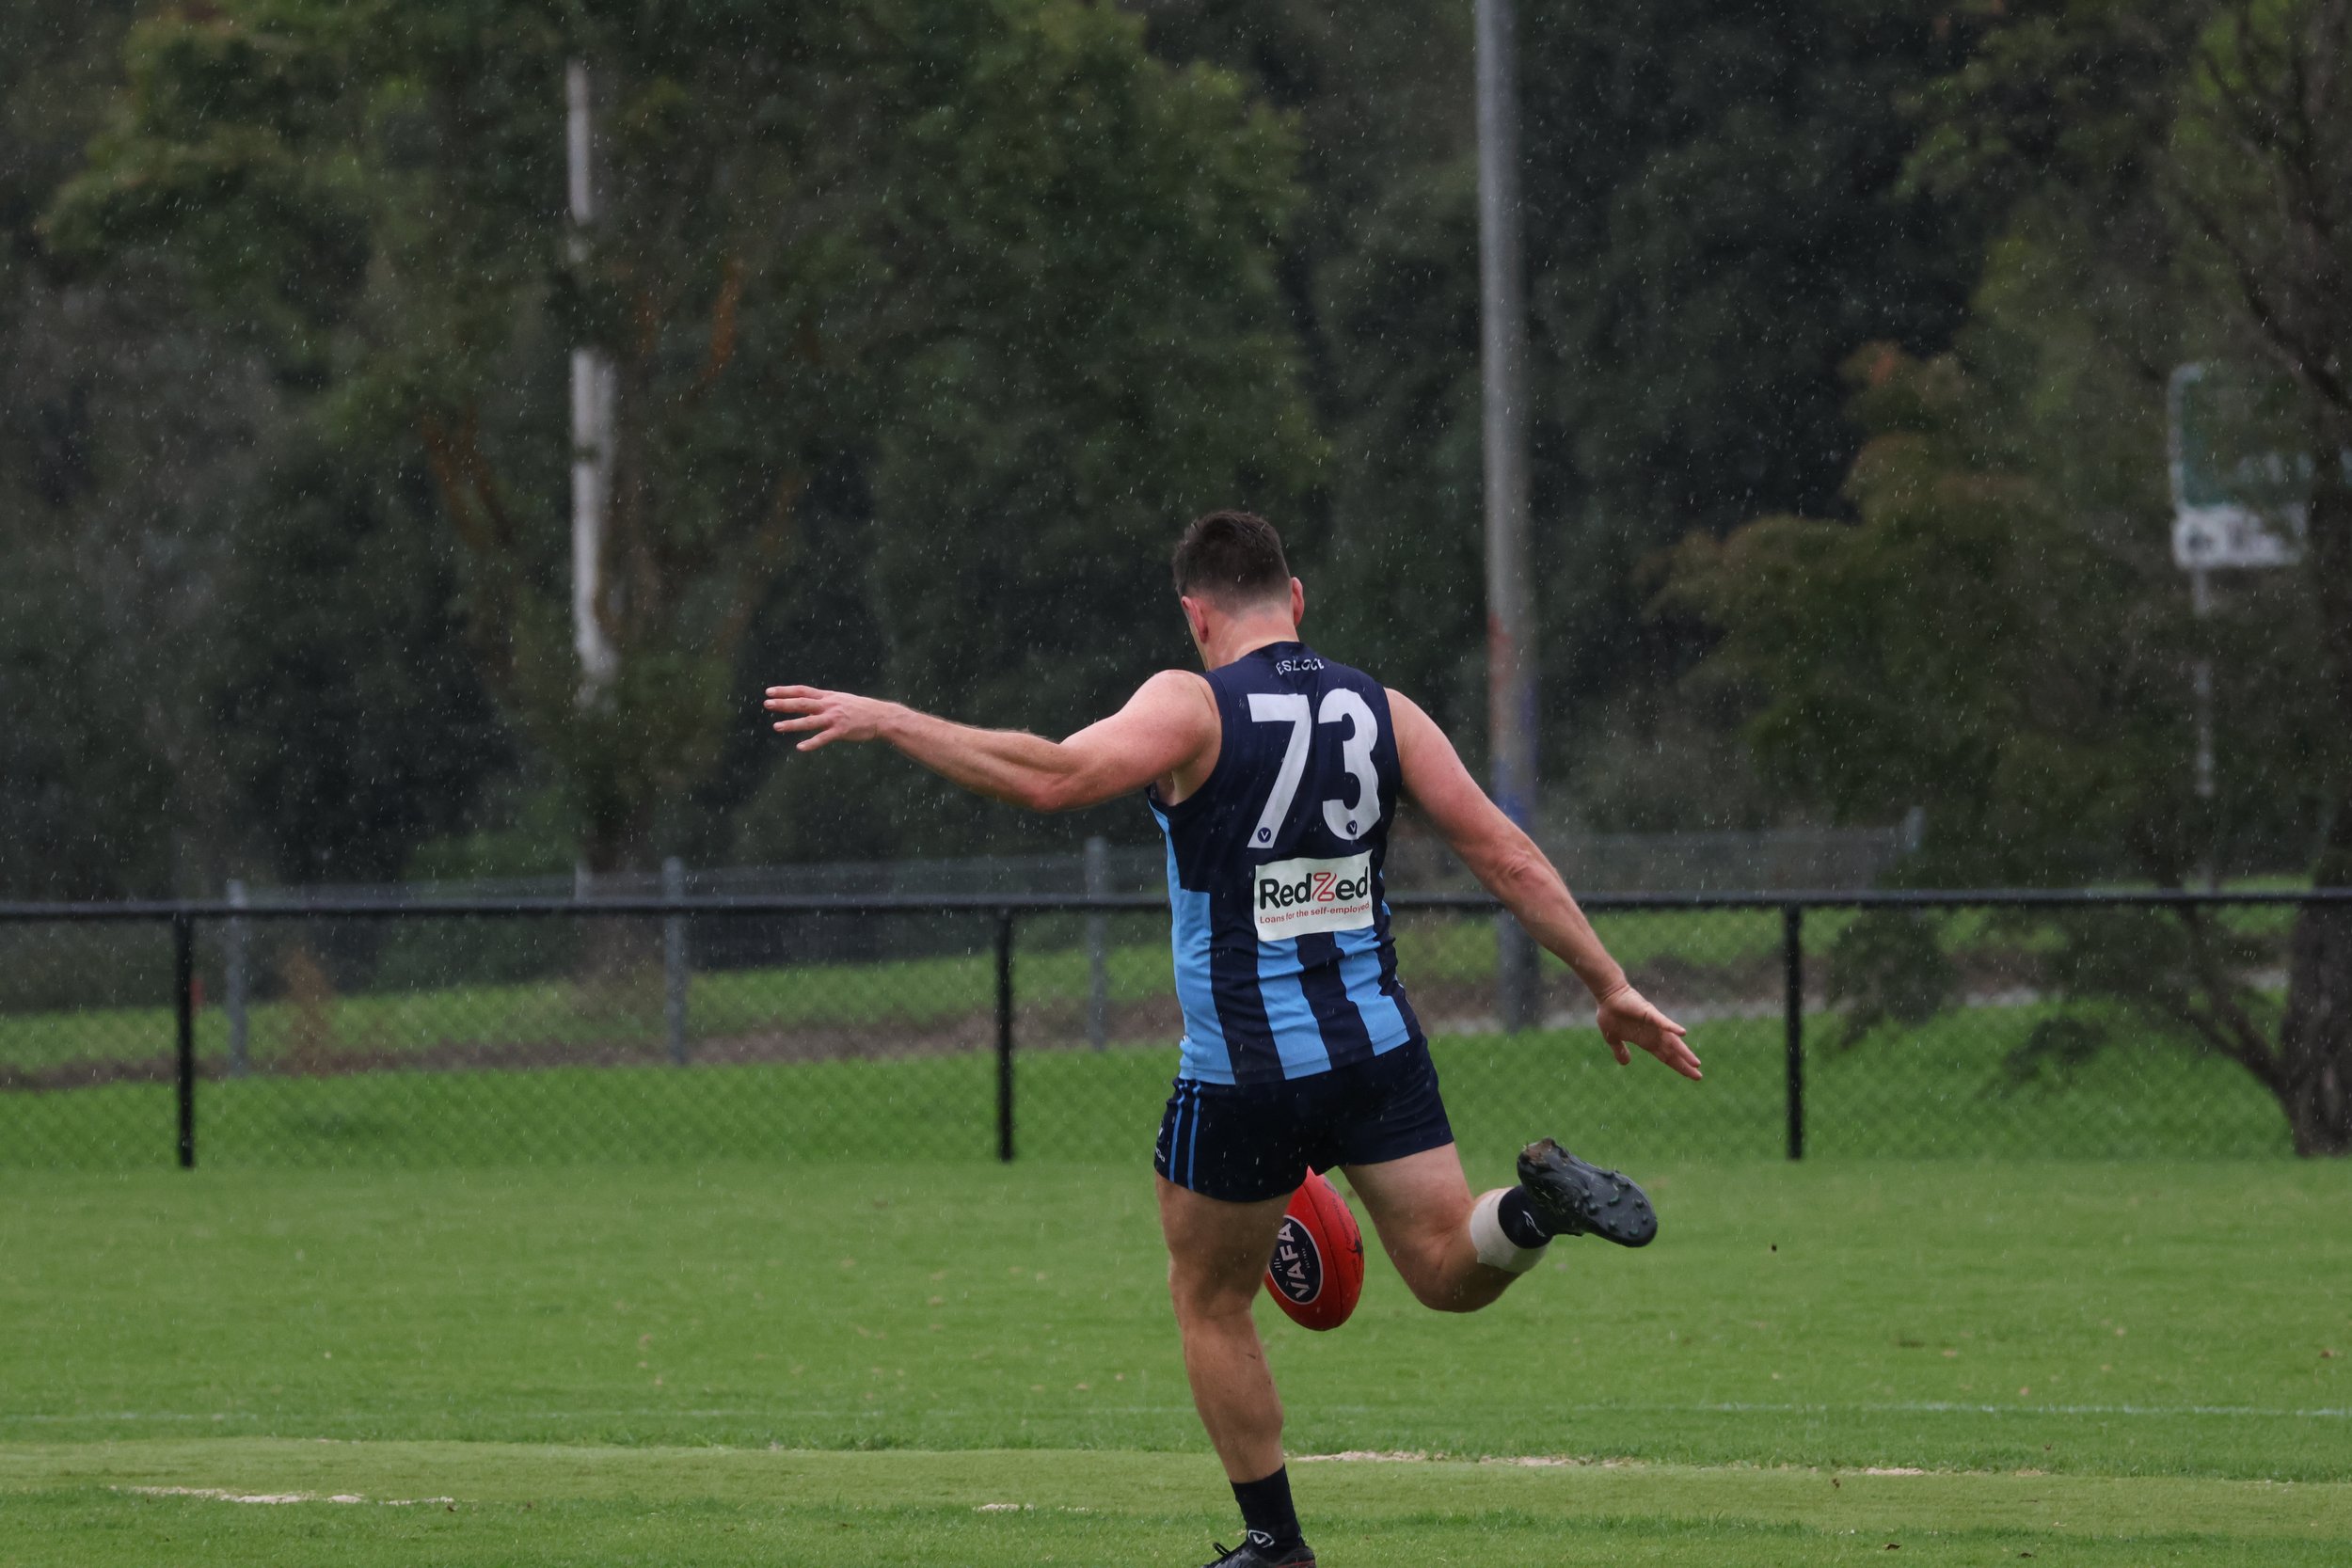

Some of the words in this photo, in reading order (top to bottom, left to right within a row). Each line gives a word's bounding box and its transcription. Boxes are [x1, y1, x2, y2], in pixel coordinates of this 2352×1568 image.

[1247, 688, 1381, 848] 73
[1259, 866, 1368, 910] RedZed
[1260, 915, 1286, 925] Loans
[1285, 912, 1295, 921] for
[1296, 909, 1310, 918] the
[1311, 901, 1371, 916] self-employed
[1278, 1223, 1311, 1299] VAFA
